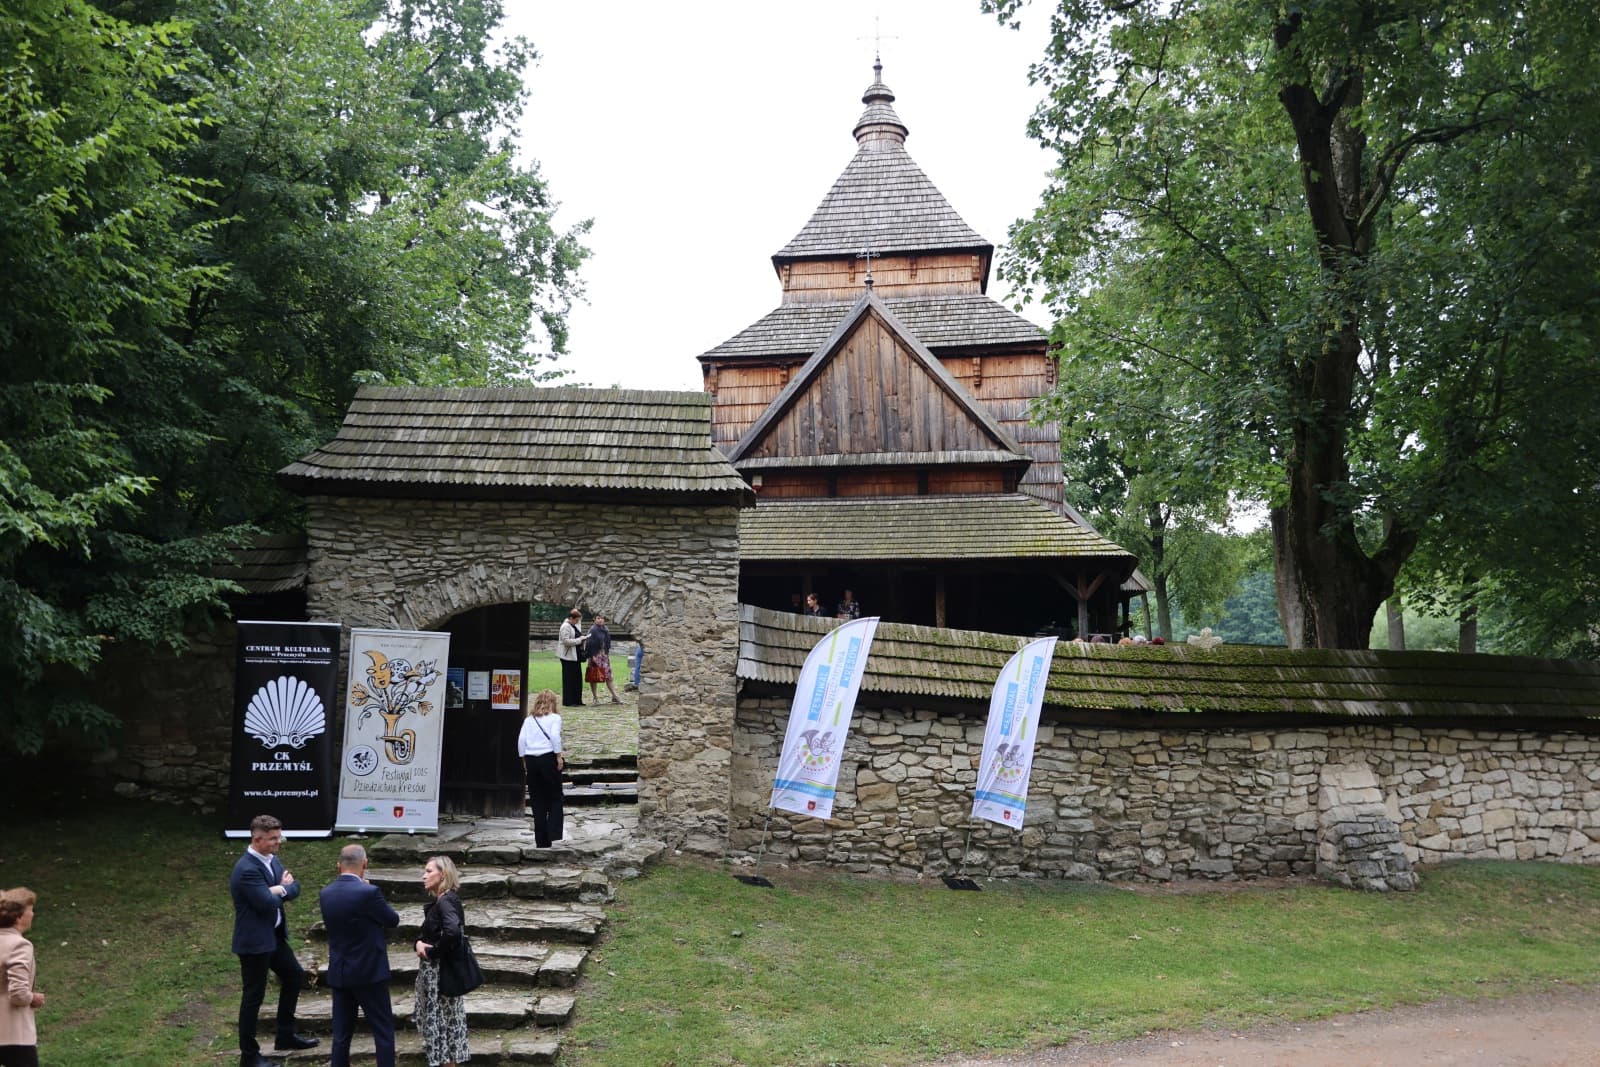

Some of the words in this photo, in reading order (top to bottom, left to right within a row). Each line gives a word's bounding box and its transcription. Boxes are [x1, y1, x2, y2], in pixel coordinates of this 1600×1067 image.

[811, 668, 829, 714] FESTIWAL
[1003, 686, 1018, 730] FESTIWAL
[274, 751, 290, 761] CK
[251, 760, 314, 771] PRZEMYŚL
[382, 766, 412, 781] Festiwal
[353, 778, 397, 793] Dziedzictwa
[399, 780, 426, 793] Kresów
[243, 789, 319, 798] www.ck.przemysl.pl
